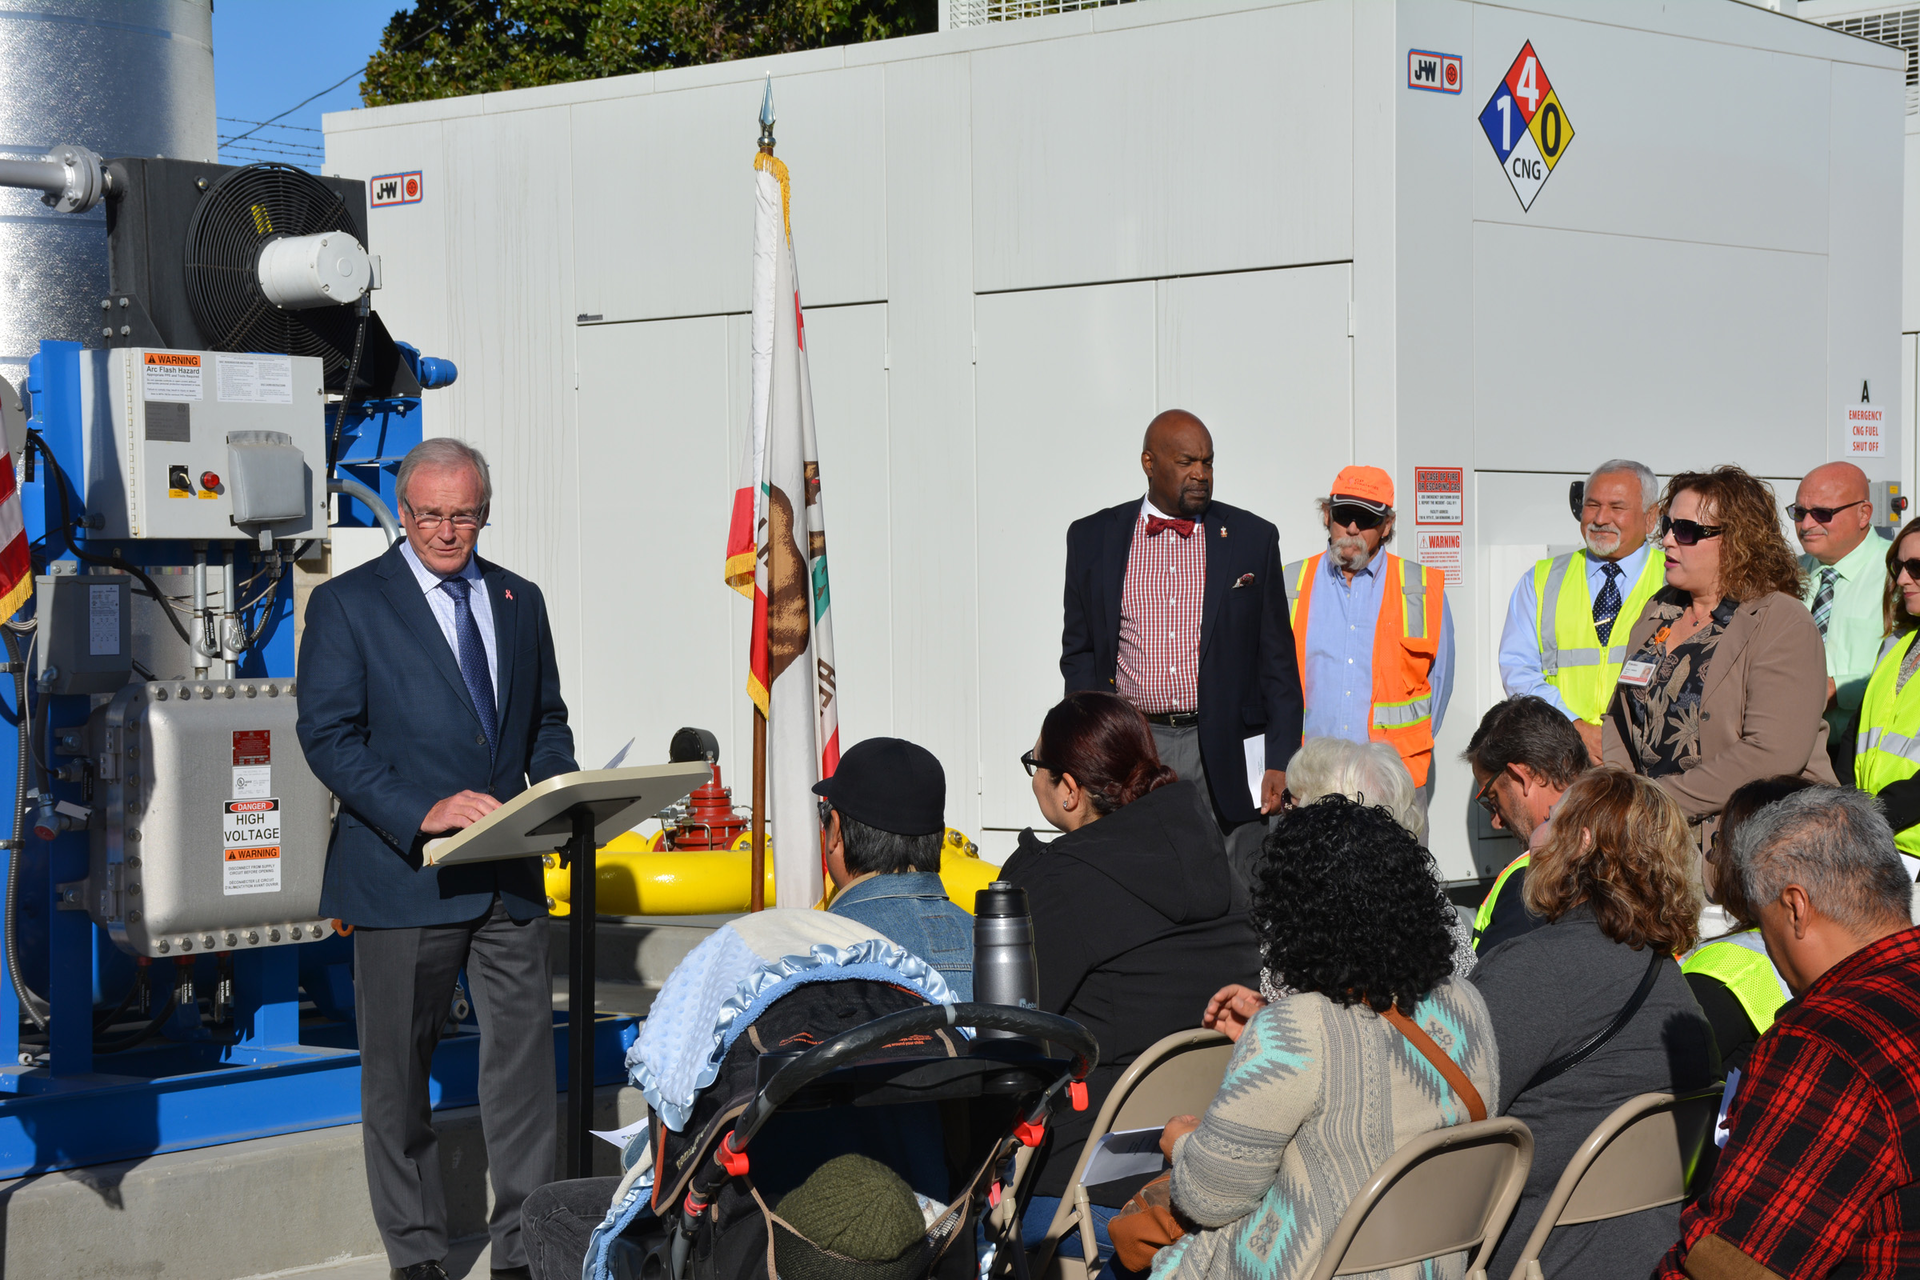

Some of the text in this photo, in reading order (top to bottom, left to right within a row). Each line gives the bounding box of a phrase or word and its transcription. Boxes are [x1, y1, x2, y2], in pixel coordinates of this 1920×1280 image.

[1516, 55, 1539, 112] 4
[1496, 95, 1511, 151] 1
[1541, 102, 1561, 157] 0
[1512, 157, 1541, 180] CNG
[158, 355, 198, 365] WARNING
[1861, 380, 1870, 403] A
[1848, 410, 1882, 421] EMERGENCY
[1853, 426, 1879, 436] CNG FUEL
[1853, 441, 1879, 452] SHUT OFF
[1420, 472, 1458, 481] IN CASE OF FIRE
[1418, 482, 1460, 491] OR ESCAPING GAS
[1428, 535, 1460, 549] WARNING
[237, 803, 267, 811] DANGER
[236, 813, 265, 825] HIGH
[224, 828, 280, 842] VOLTAGE
[238, 848, 277, 859] WARNING
